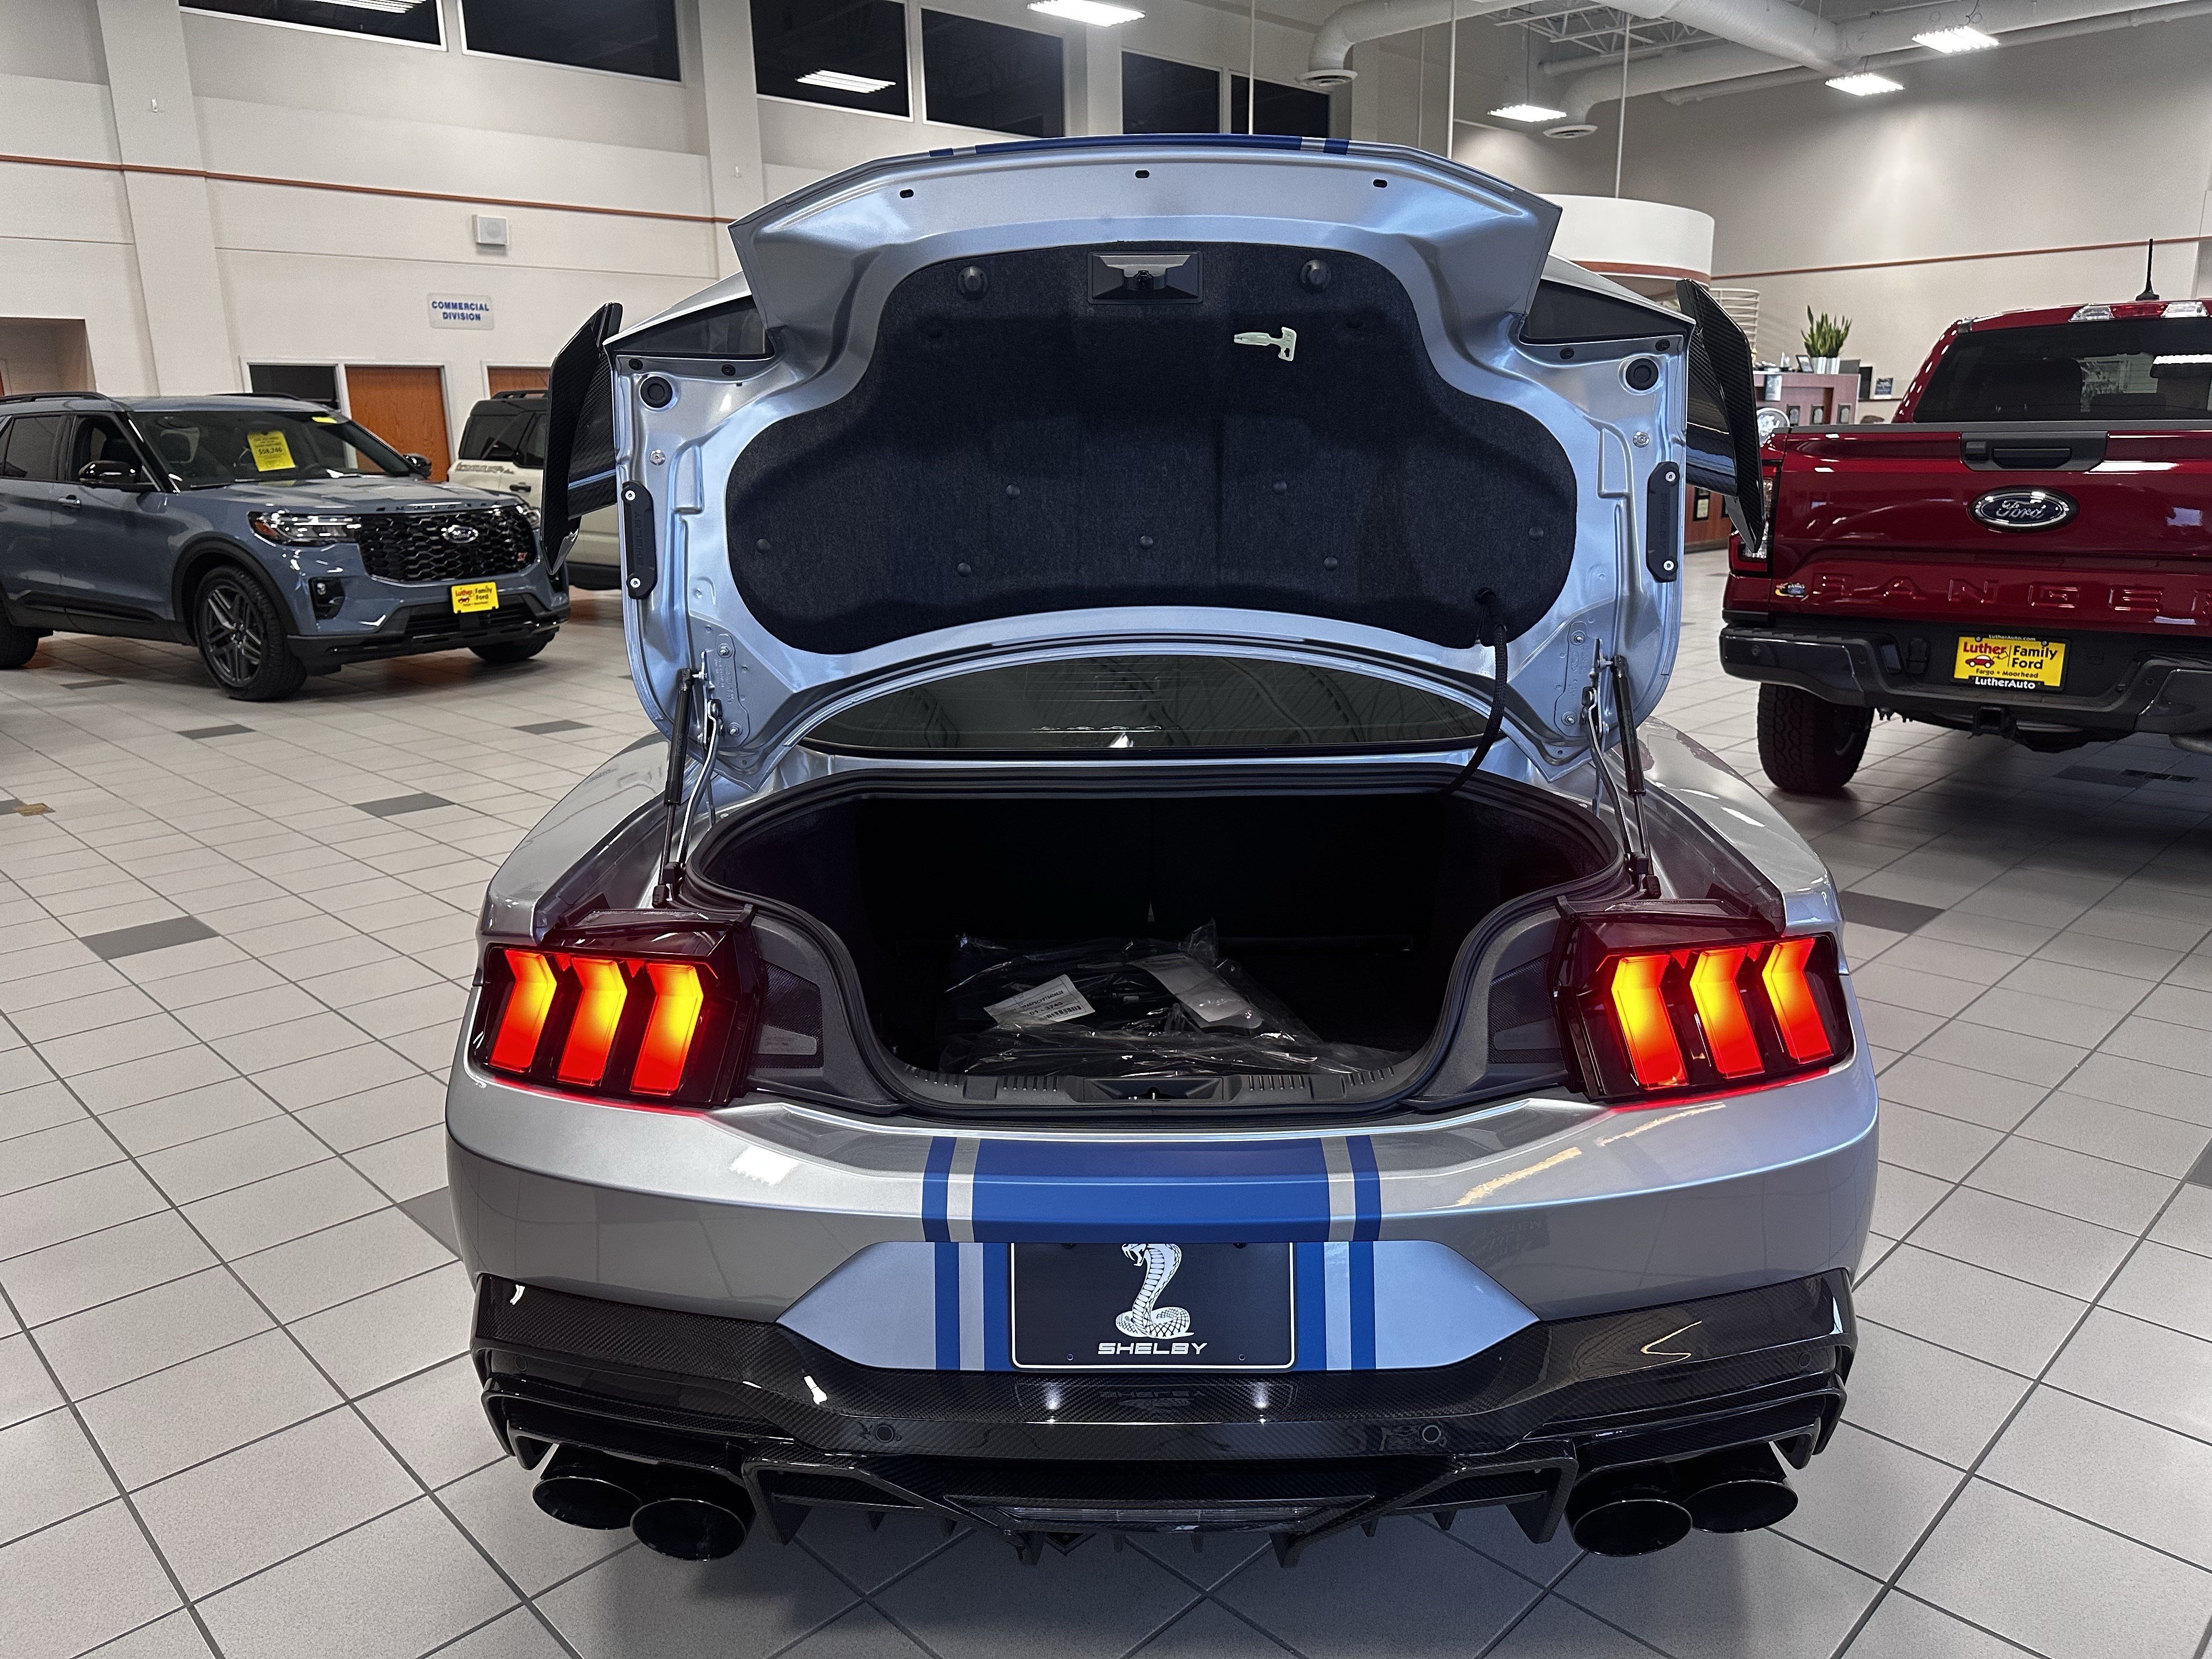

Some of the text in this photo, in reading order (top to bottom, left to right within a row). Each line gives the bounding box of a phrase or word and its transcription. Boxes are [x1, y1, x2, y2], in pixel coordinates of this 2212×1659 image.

[431, 301, 489, 311] COMMERCIAL
[442, 312, 481, 320] DIVISION
[1995, 499, 2047, 519] Ford
[1962, 641, 2058, 661] Luther Family
[2011, 657, 2044, 670] Ford
[1976, 668, 2039, 679] Fargo Moorhead
[1974, 676, 2036, 690] LutherAuto
[1098, 1342, 1207, 1355] SHELBY
